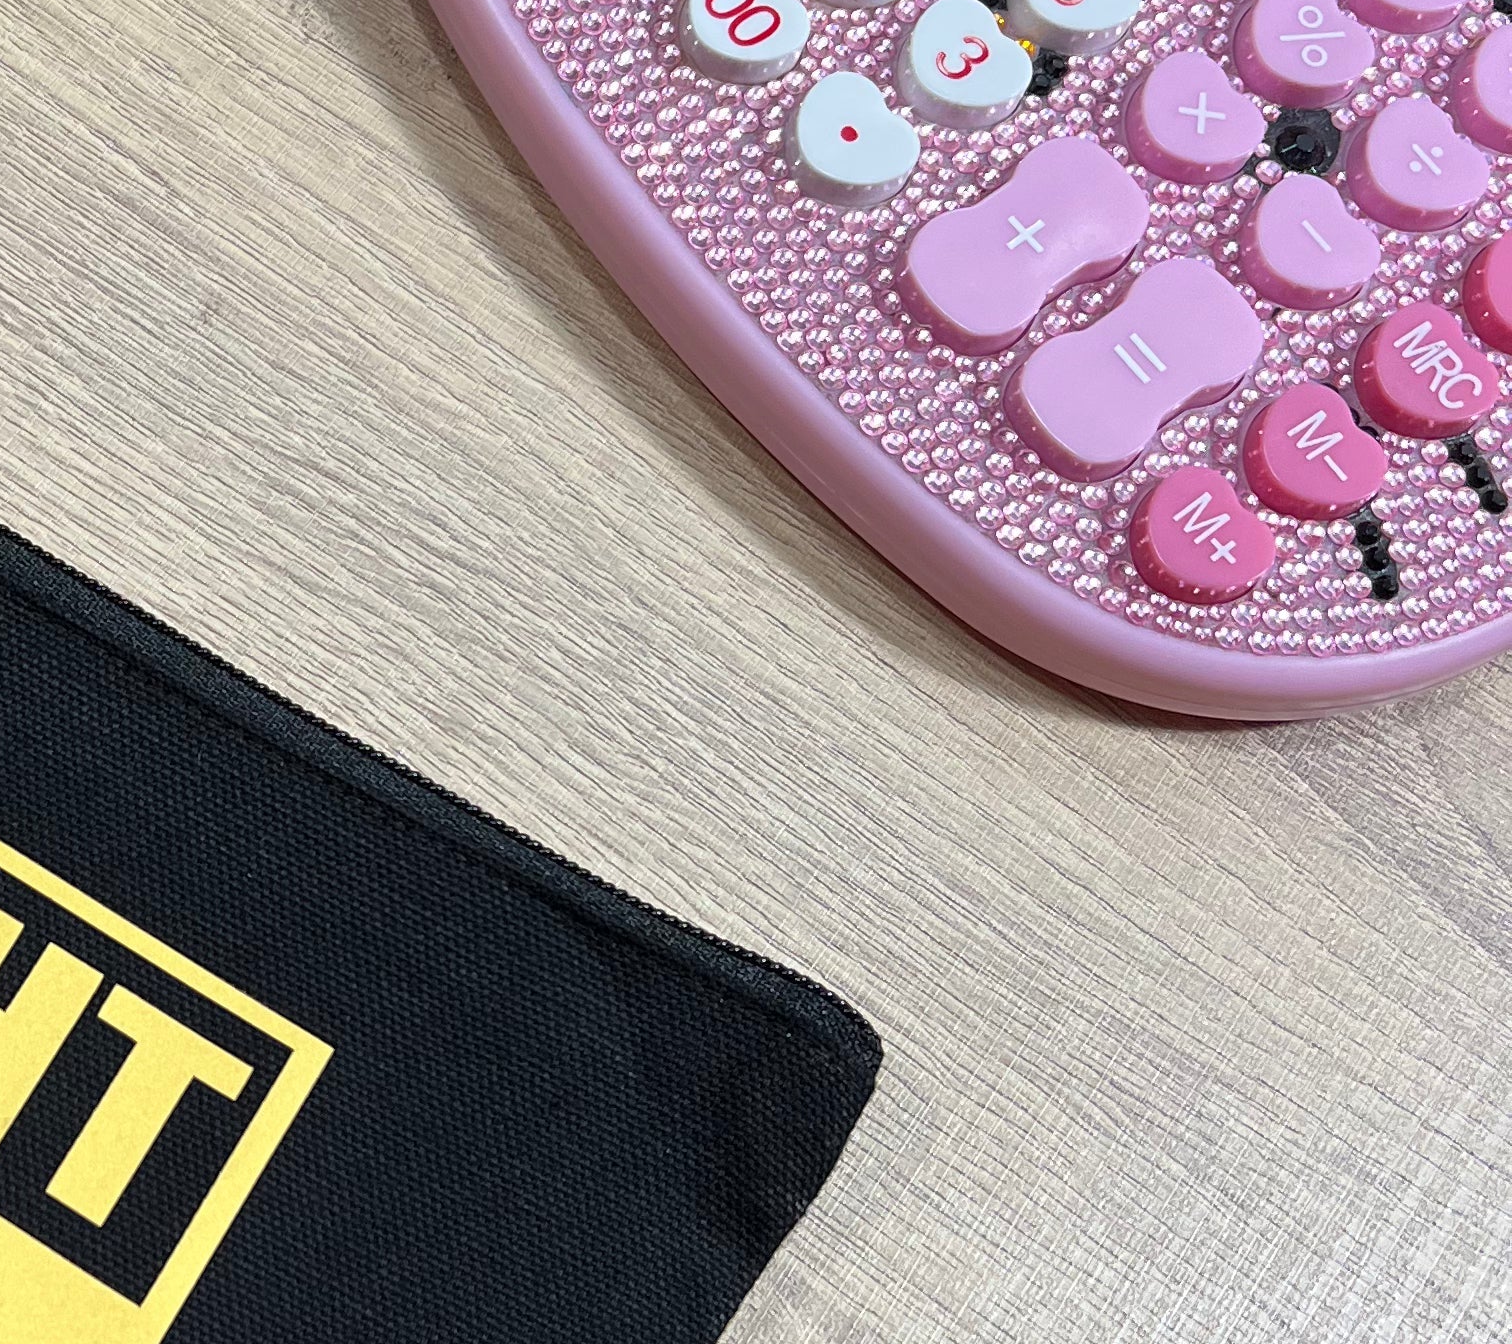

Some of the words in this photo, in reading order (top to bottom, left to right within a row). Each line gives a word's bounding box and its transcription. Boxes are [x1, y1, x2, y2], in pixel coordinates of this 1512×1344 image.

[936, 37, 990, 80] 3
[1393, 320, 1483, 410] MRC
[1286, 409, 1349, 482] M-
[1172, 490, 1237, 565] M+
